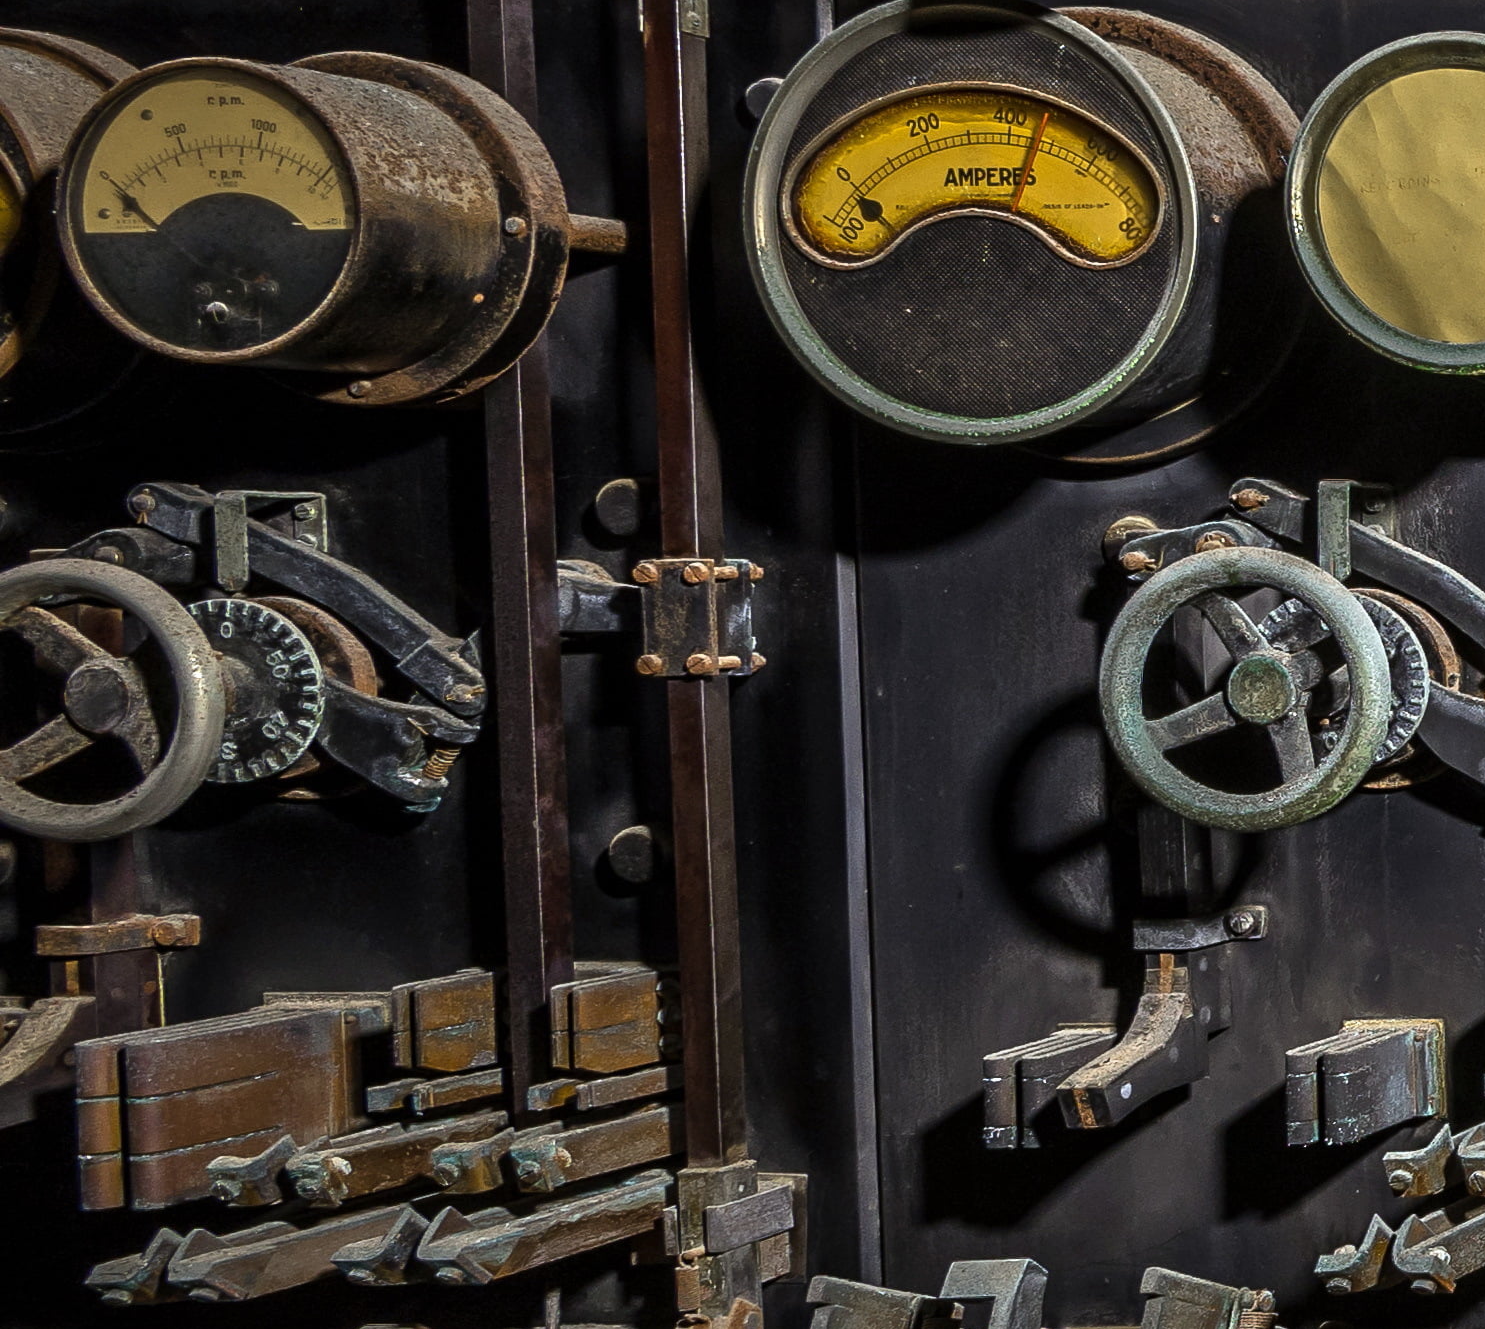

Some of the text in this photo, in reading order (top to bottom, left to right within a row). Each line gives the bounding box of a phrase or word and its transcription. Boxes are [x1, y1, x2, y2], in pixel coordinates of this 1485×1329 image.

[251, 118, 277, 135] 1000
[906, 112, 942, 134] 200
[994, 109, 1028, 128] 400
[164, 123, 187, 138] 500
[100, 170, 110, 181] 0
[836, 166, 851, 183] 0
[944, 168, 1037, 188] AMPERES
[839, 217, 865, 244] 100
[220, 621, 233, 639] 0
